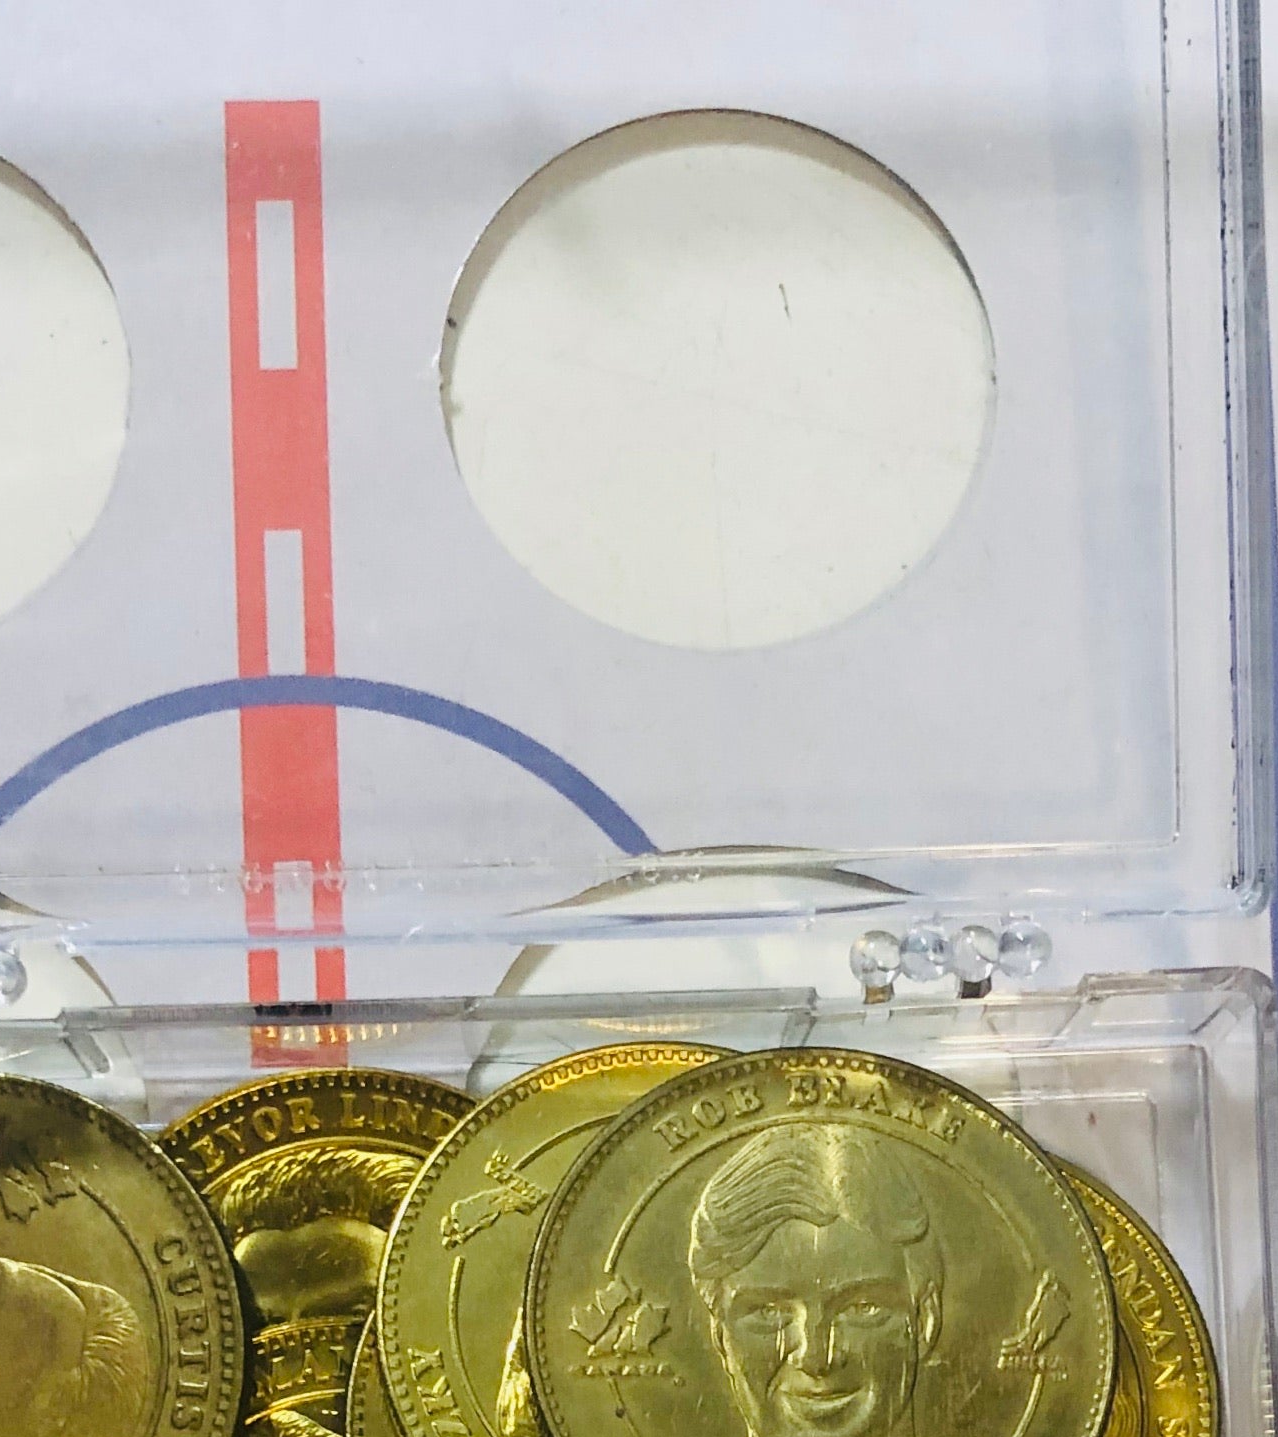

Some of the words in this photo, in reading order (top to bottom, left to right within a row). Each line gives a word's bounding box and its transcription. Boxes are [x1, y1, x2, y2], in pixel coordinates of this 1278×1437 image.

[652, 1081, 765, 1152] ROB
[786, 1074, 966, 1145] BLAKE
[153, 1233, 213, 1435] CURTIS
